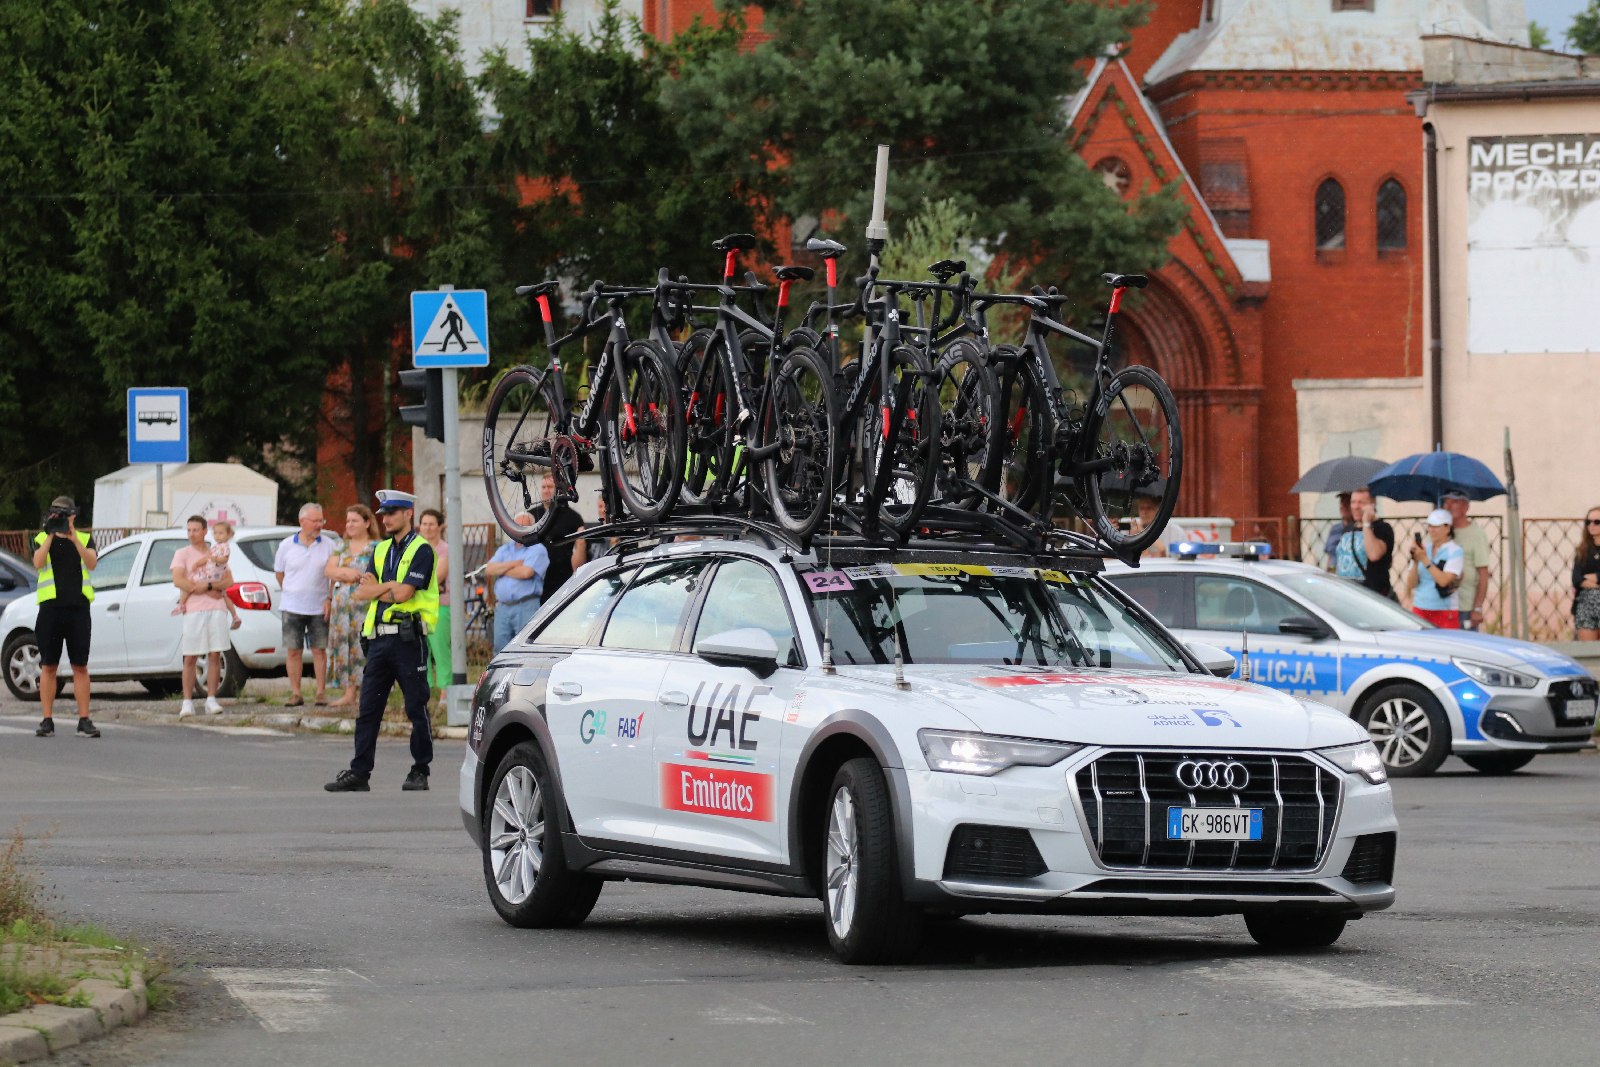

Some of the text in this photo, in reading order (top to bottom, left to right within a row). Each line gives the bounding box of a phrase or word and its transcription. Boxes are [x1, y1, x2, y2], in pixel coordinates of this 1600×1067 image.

[579, 352, 608, 429] COLNAGO
[812, 575, 845, 588] 24
[1233, 656, 1317, 685] OLICJA
[687, 681, 775, 751] UAE
[681, 770, 753, 813] Emirates
